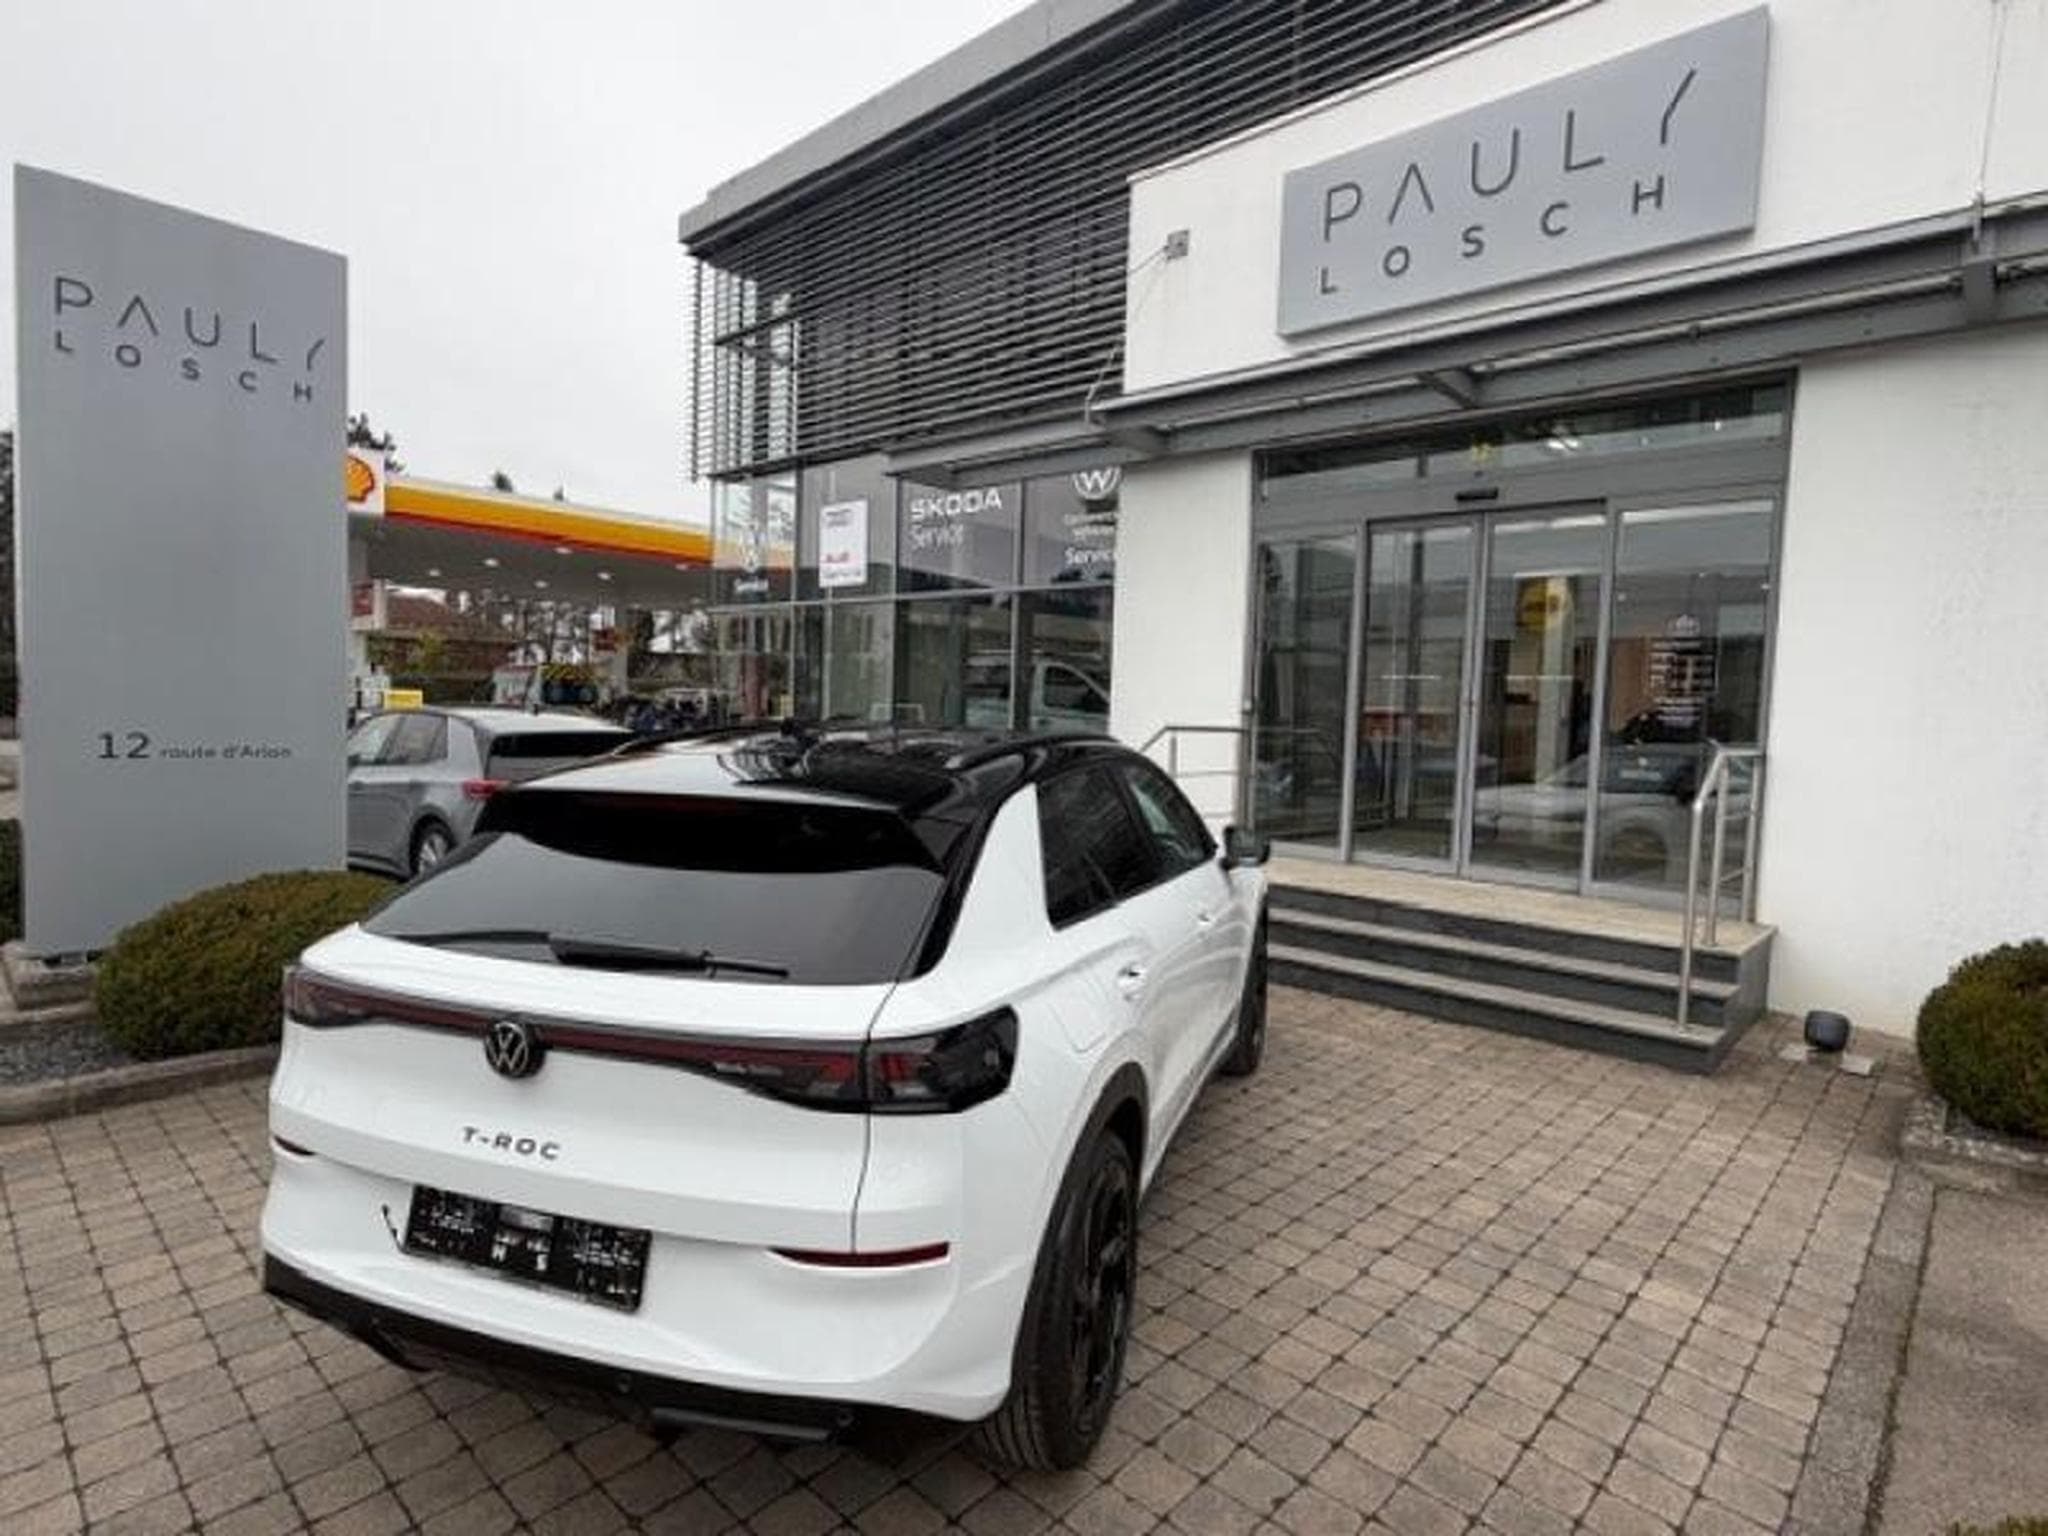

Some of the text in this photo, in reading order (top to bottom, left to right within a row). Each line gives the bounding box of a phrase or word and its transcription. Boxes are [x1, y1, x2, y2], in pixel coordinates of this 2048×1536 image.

[1320, 174, 1665, 296] LOSCH
[54, 329, 313, 403] LOSCH
[97, 731, 150, 760] 12
[159, 744, 217, 759] route
[461, 1125, 561, 1161] T-ROC
